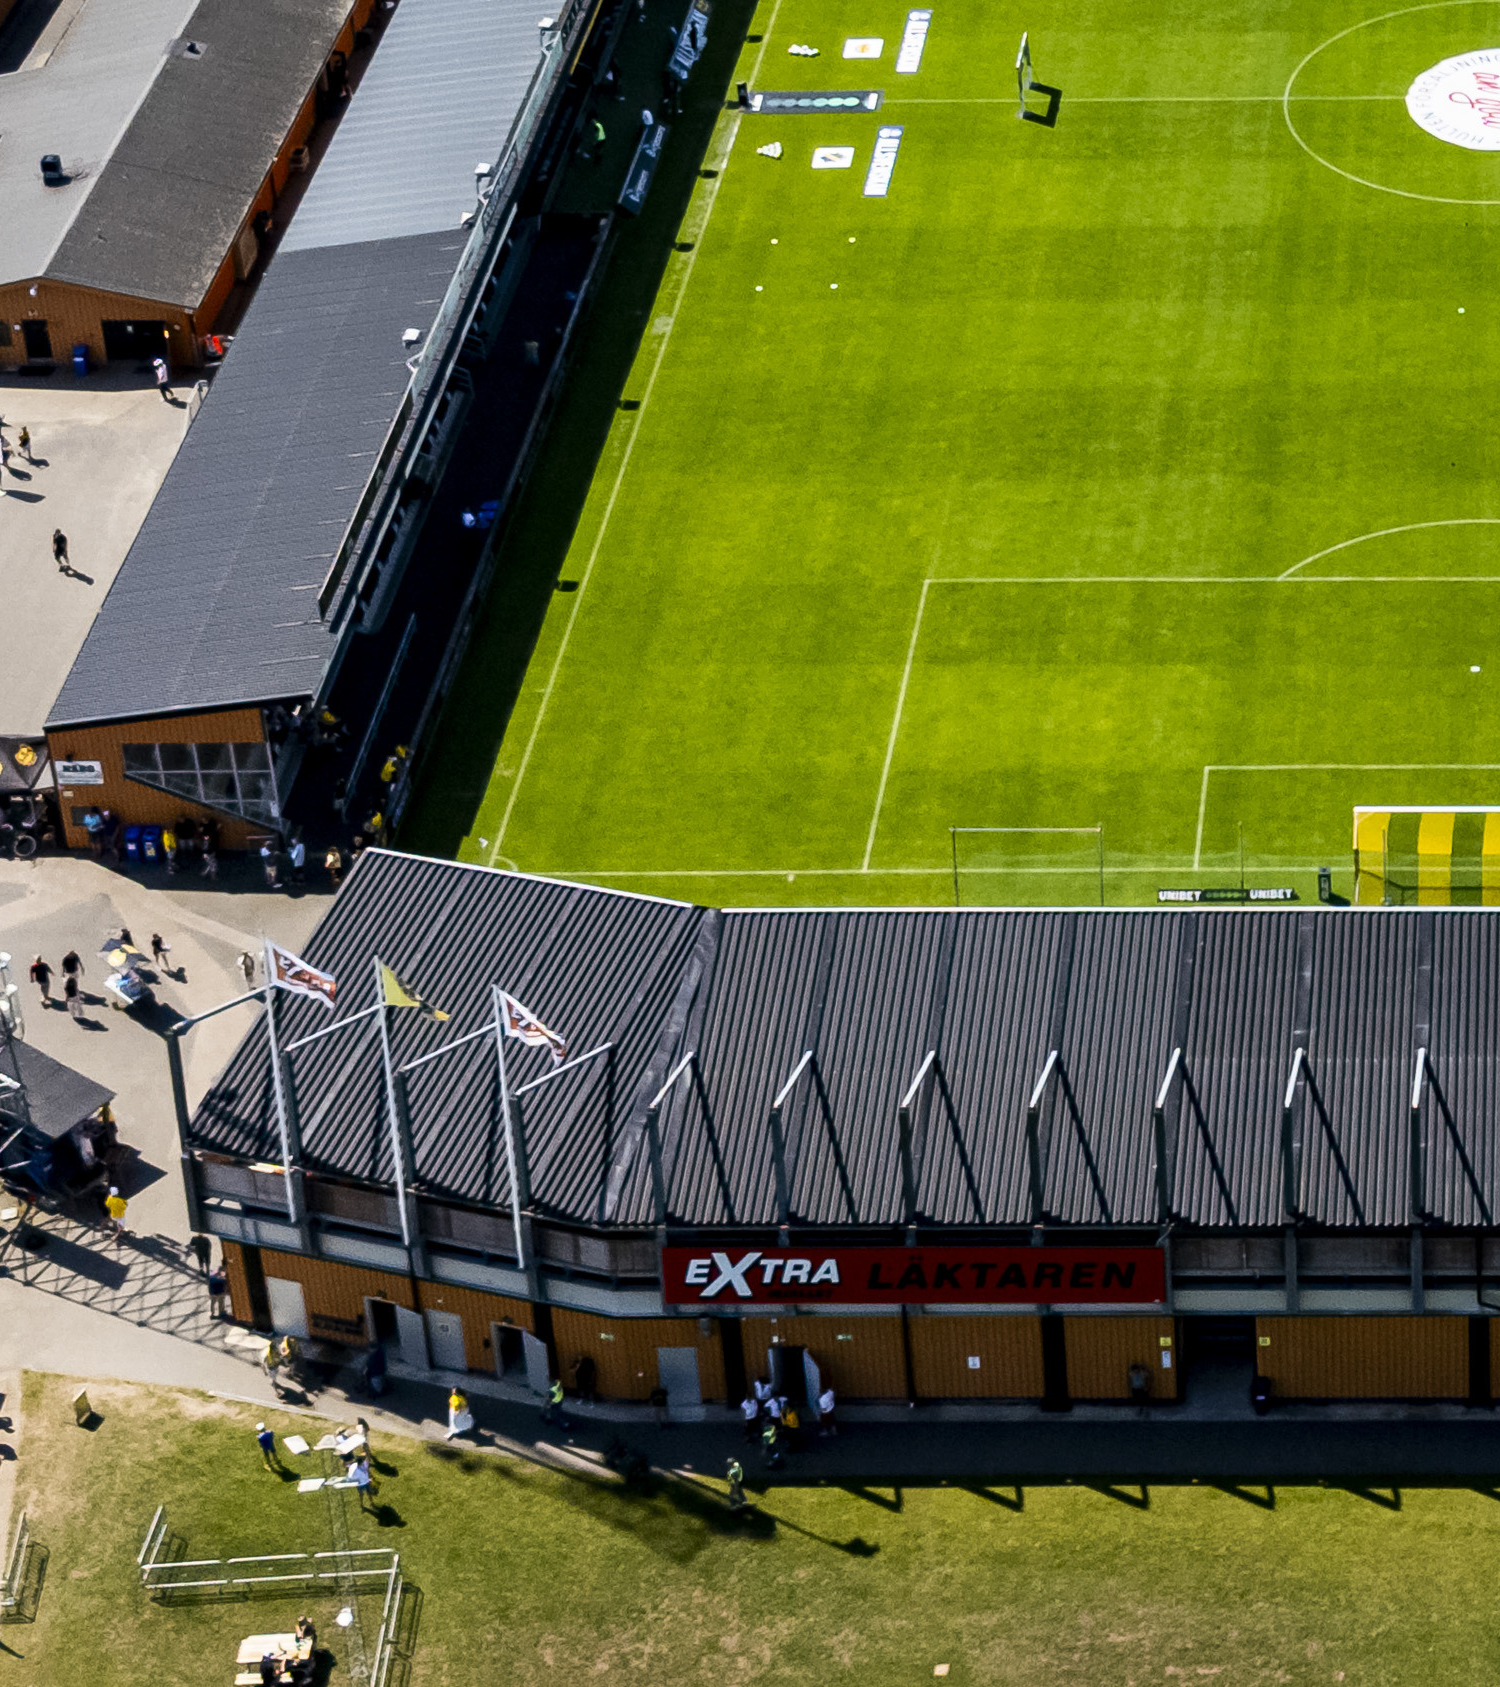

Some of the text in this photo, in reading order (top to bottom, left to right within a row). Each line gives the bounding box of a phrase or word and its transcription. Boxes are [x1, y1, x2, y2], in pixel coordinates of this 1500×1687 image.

[1158, 891, 1201, 901] UNIBET
[1249, 889, 1293, 899] UNIBET
[685, 1251, 1136, 1298] EXTRA LÄKTAREN
